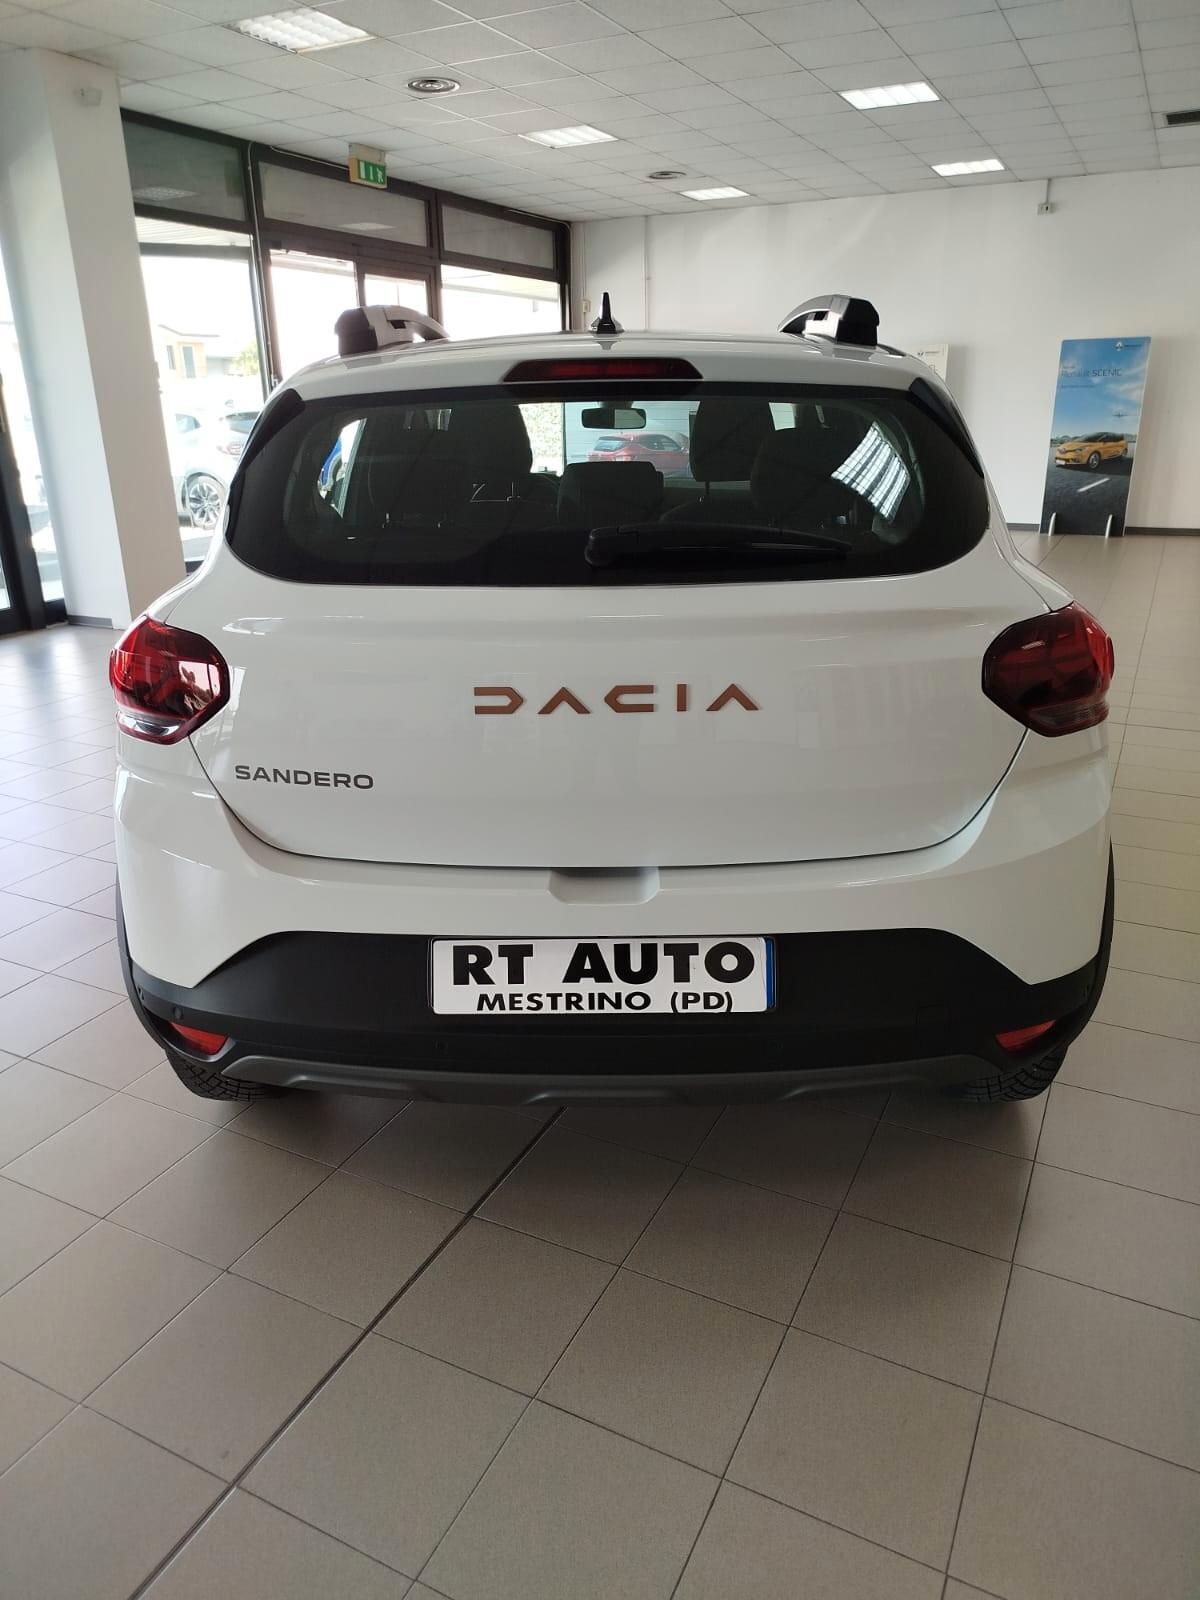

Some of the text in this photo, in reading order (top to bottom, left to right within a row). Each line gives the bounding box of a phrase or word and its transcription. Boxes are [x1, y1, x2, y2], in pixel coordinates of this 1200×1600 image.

[474, 684, 759, 715] DACIA
[235, 765, 374, 789] SANDERO
[453, 942, 755, 985] RT AUTO
[476, 991, 733, 1013] MESTRINO (PD)
